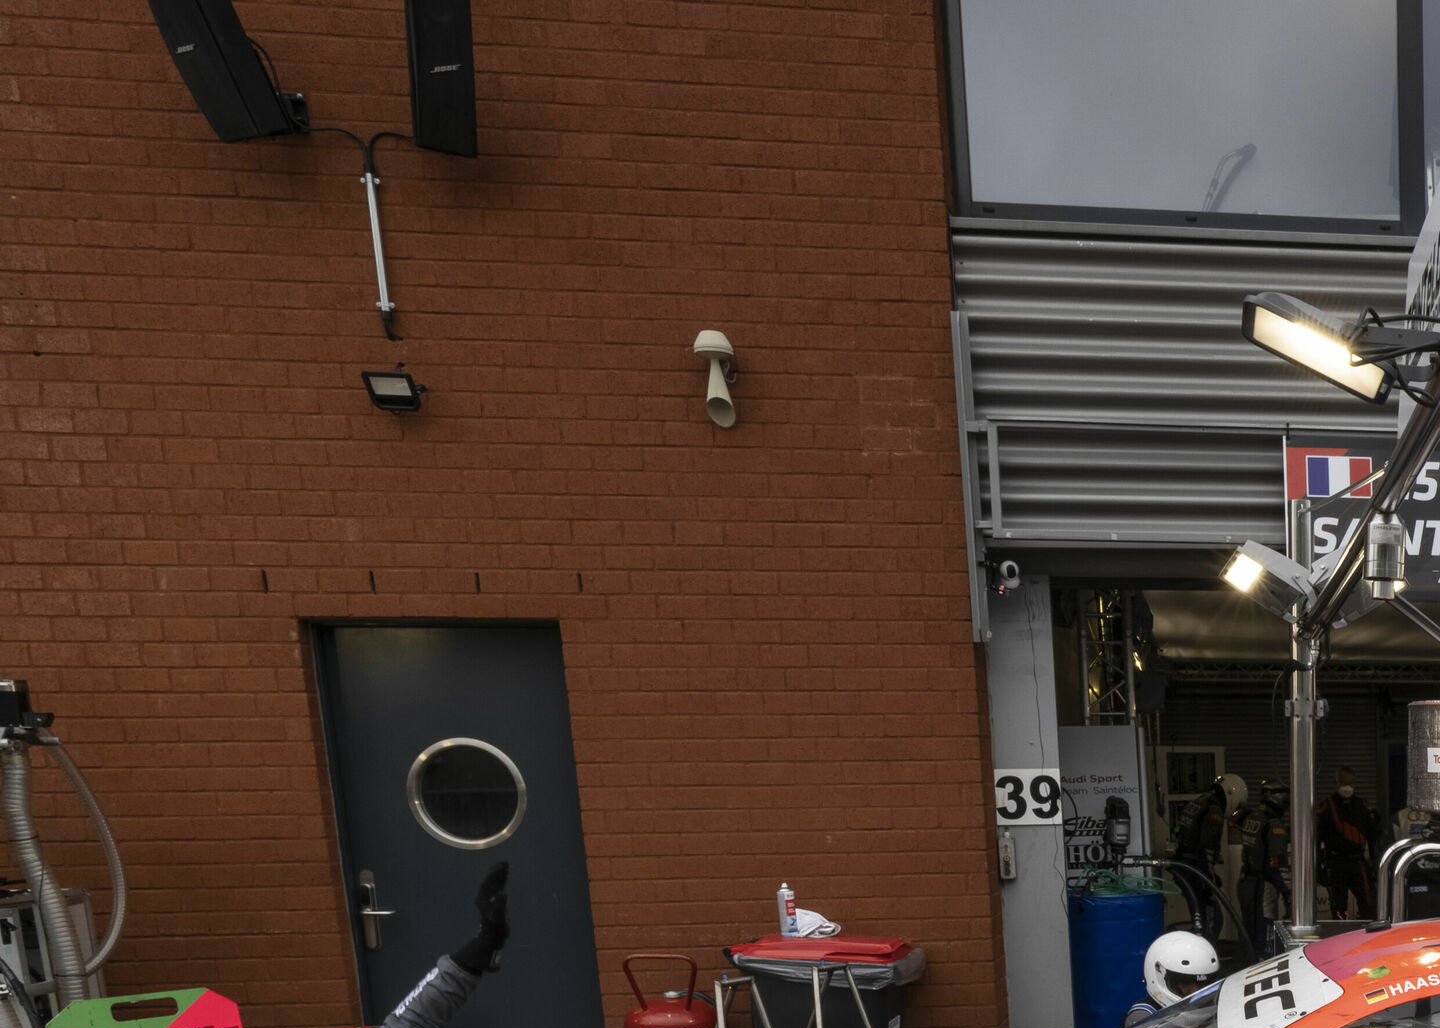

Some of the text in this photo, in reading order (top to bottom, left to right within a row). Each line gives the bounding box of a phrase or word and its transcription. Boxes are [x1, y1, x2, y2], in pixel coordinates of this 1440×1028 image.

[1061, 774, 1124, 785] Audi Sport
[995, 775, 1061, 820] 39
